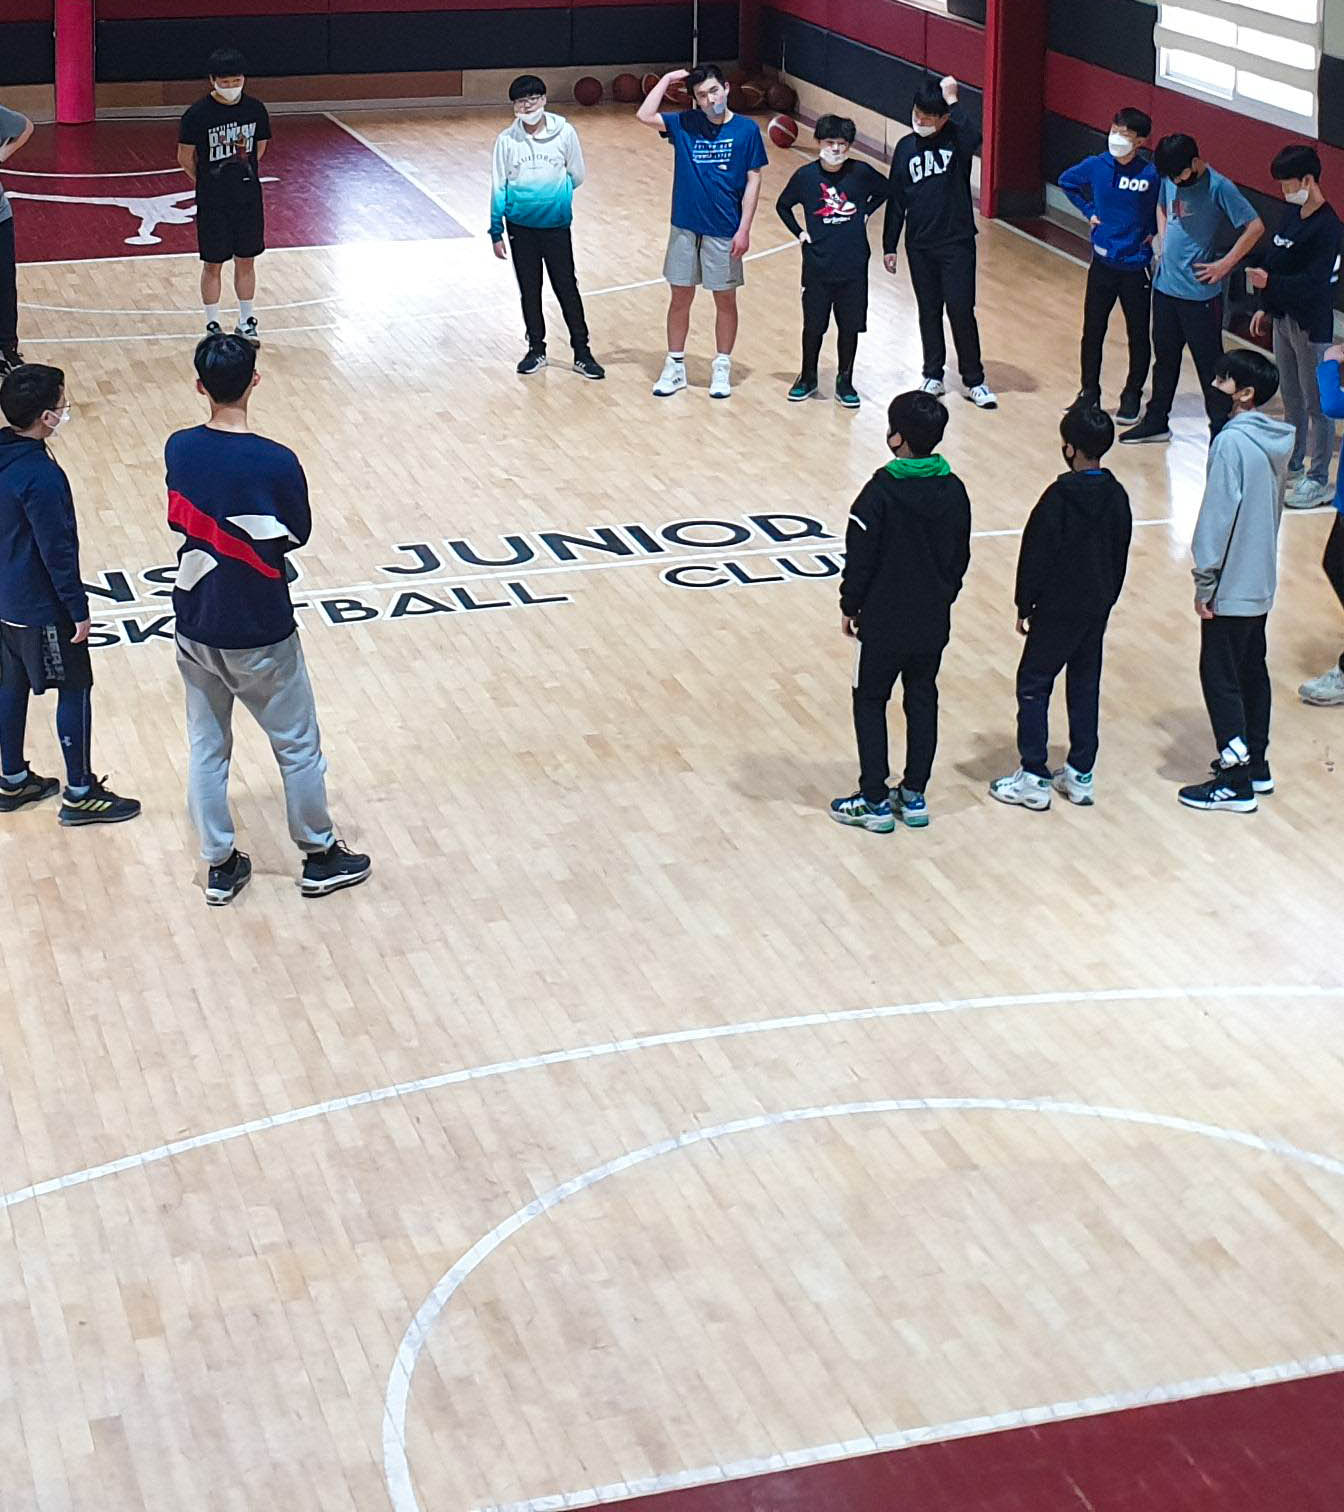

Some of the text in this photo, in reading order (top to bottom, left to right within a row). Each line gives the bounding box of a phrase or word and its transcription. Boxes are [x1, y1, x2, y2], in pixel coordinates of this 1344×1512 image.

[909, 148, 953, 183] GAP
[381, 514, 836, 575] JUNIOR
[664, 553, 848, 588] CLU
